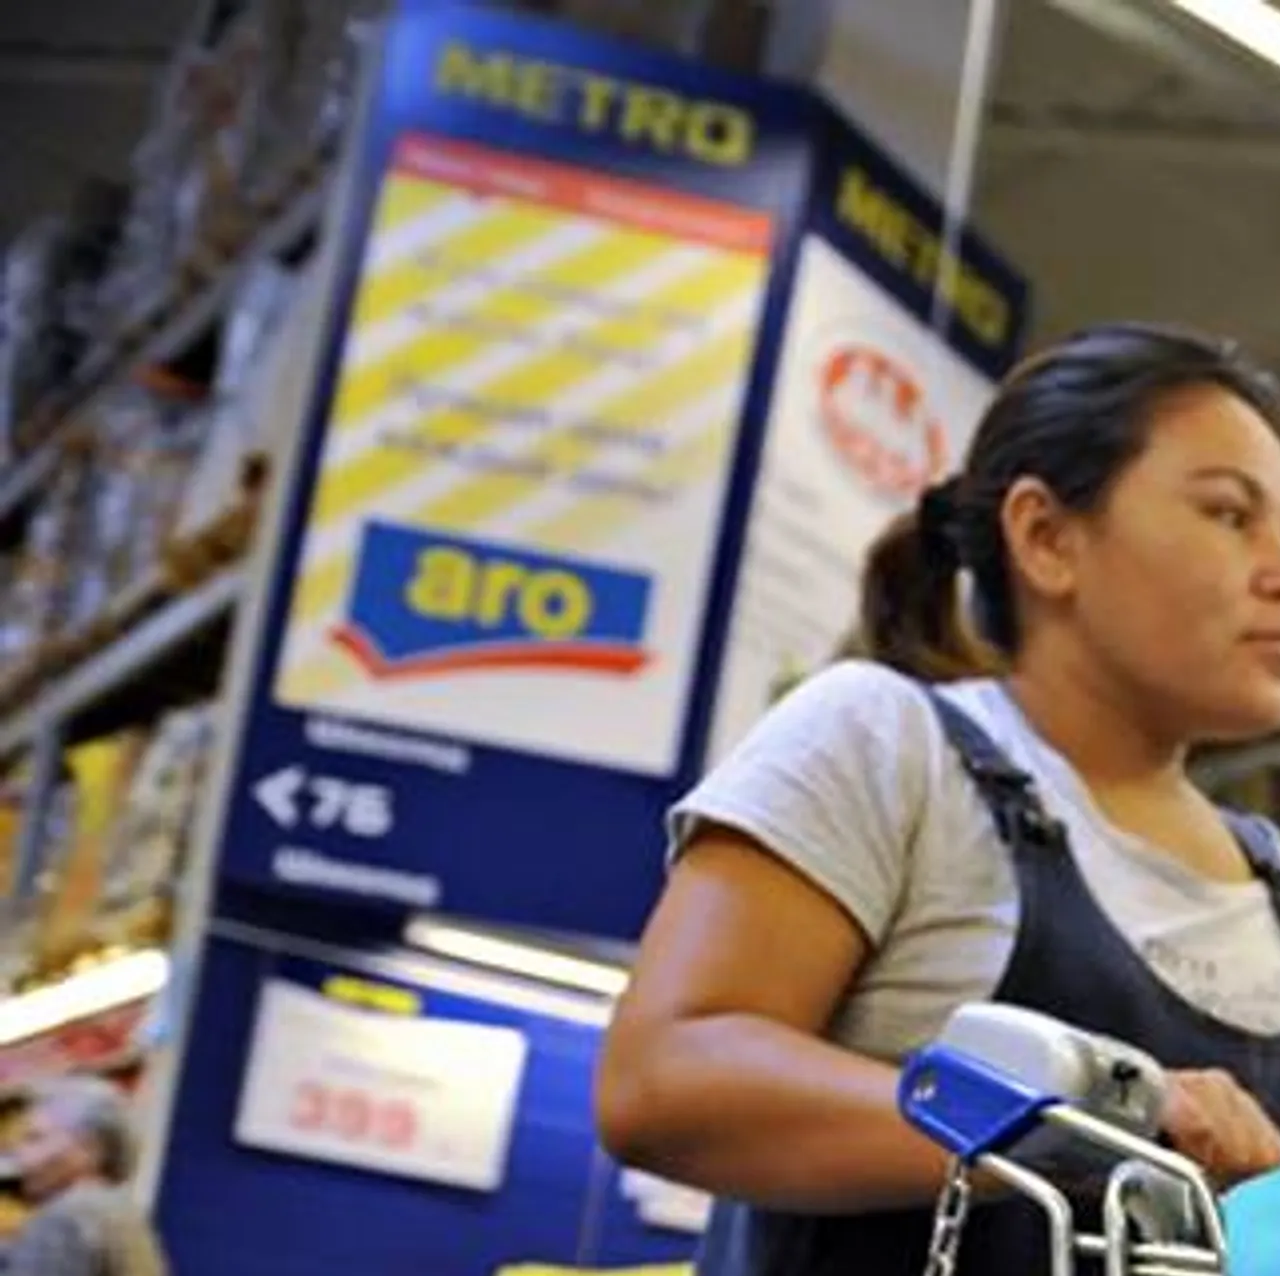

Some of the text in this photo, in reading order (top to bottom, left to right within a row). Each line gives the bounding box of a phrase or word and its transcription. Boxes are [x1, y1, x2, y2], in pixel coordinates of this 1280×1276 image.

[436, 42, 756, 167] METRO
[836, 166, 1010, 345] METRO
[406, 547, 594, 639] aro
